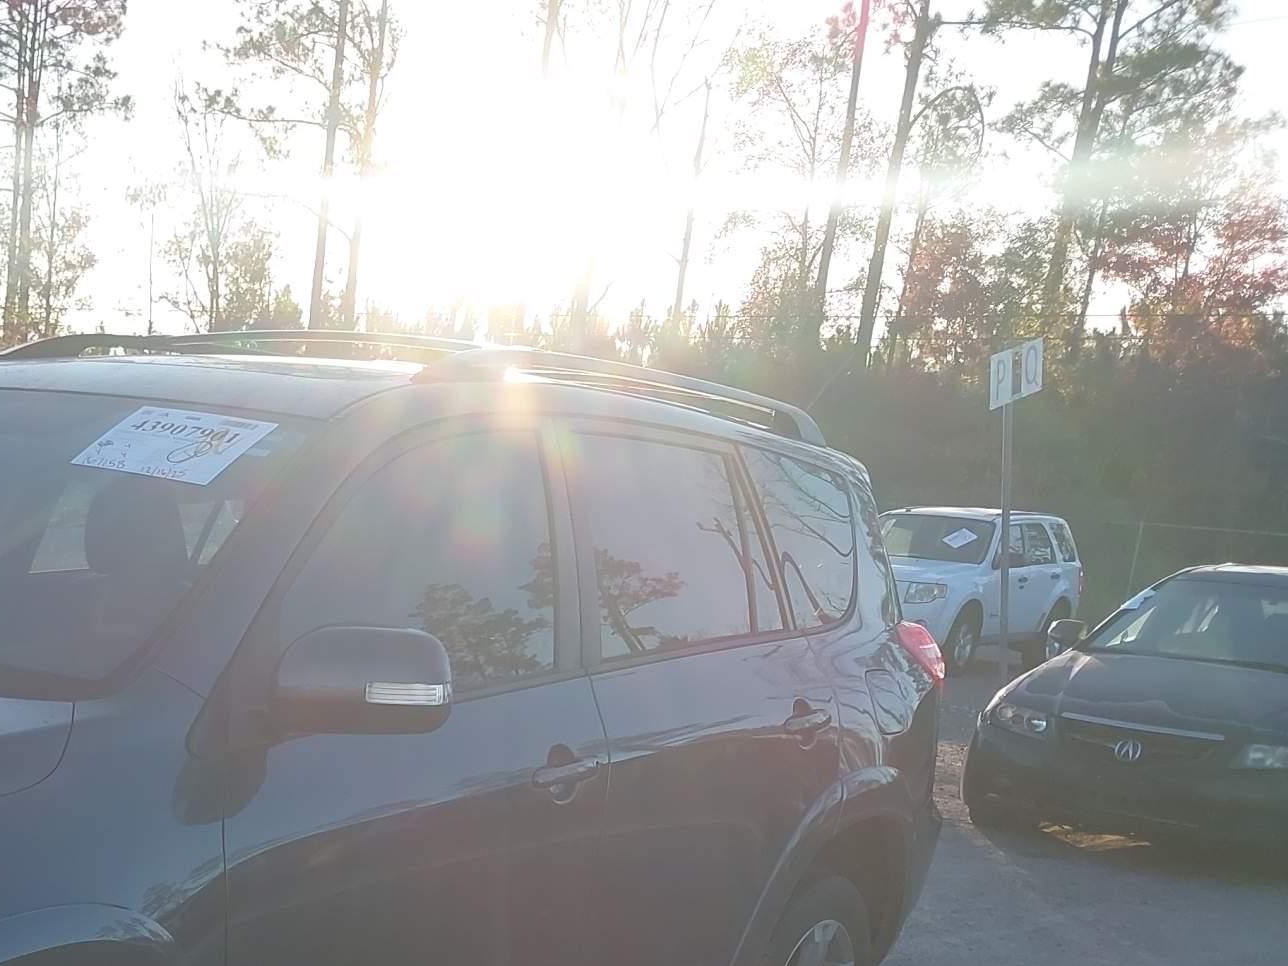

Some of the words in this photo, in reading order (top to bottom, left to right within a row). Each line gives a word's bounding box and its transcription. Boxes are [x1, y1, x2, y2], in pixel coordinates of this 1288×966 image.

[996, 359, 1006, 400] P
[1025, 344, 1039, 386] Q
[131, 419, 241, 443] 43907901
